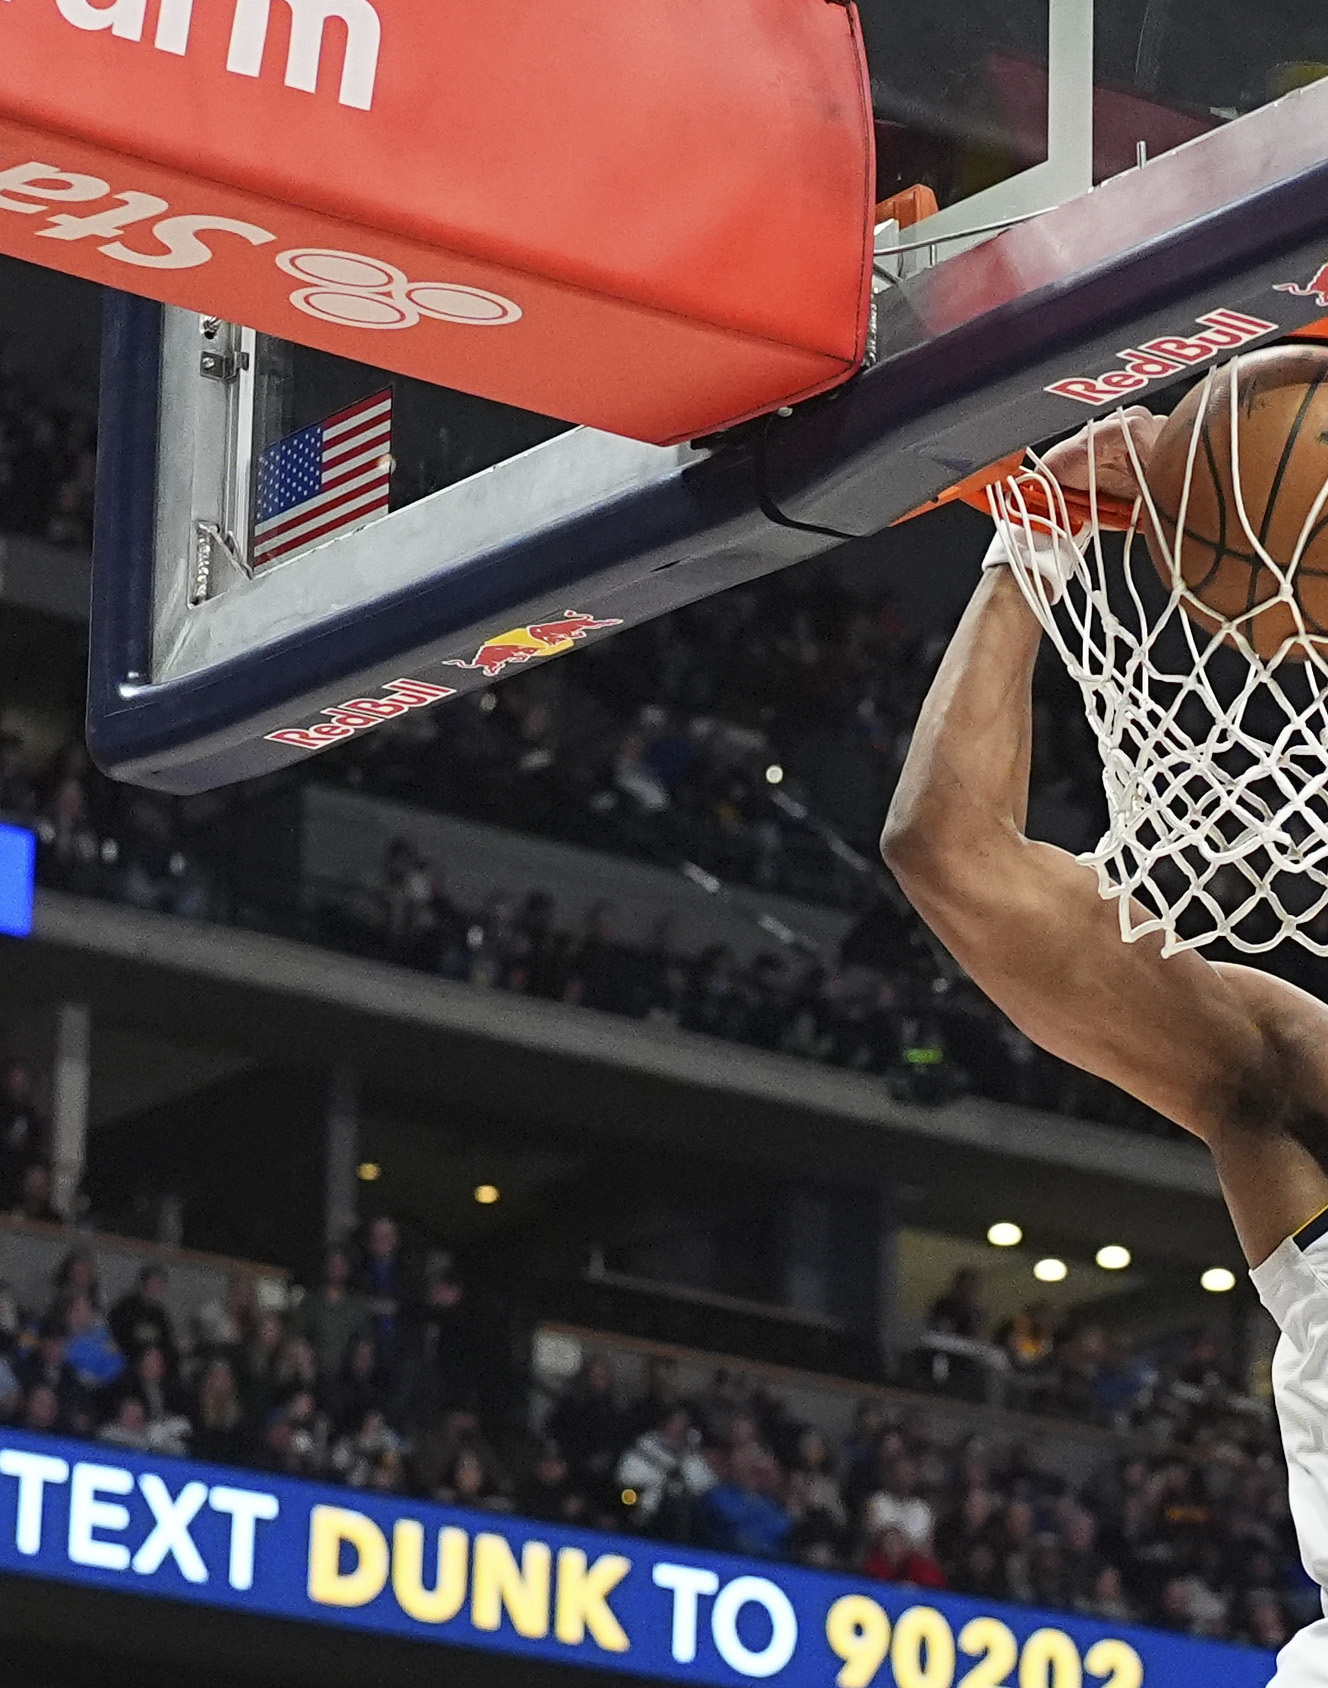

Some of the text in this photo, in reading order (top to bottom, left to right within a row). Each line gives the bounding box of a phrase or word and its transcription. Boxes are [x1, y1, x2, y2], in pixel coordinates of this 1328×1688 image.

[0, 1449, 279, 1590] TEXT
[308, 1504, 632, 1652] DUNK
[652, 1562, 798, 1678] TO
